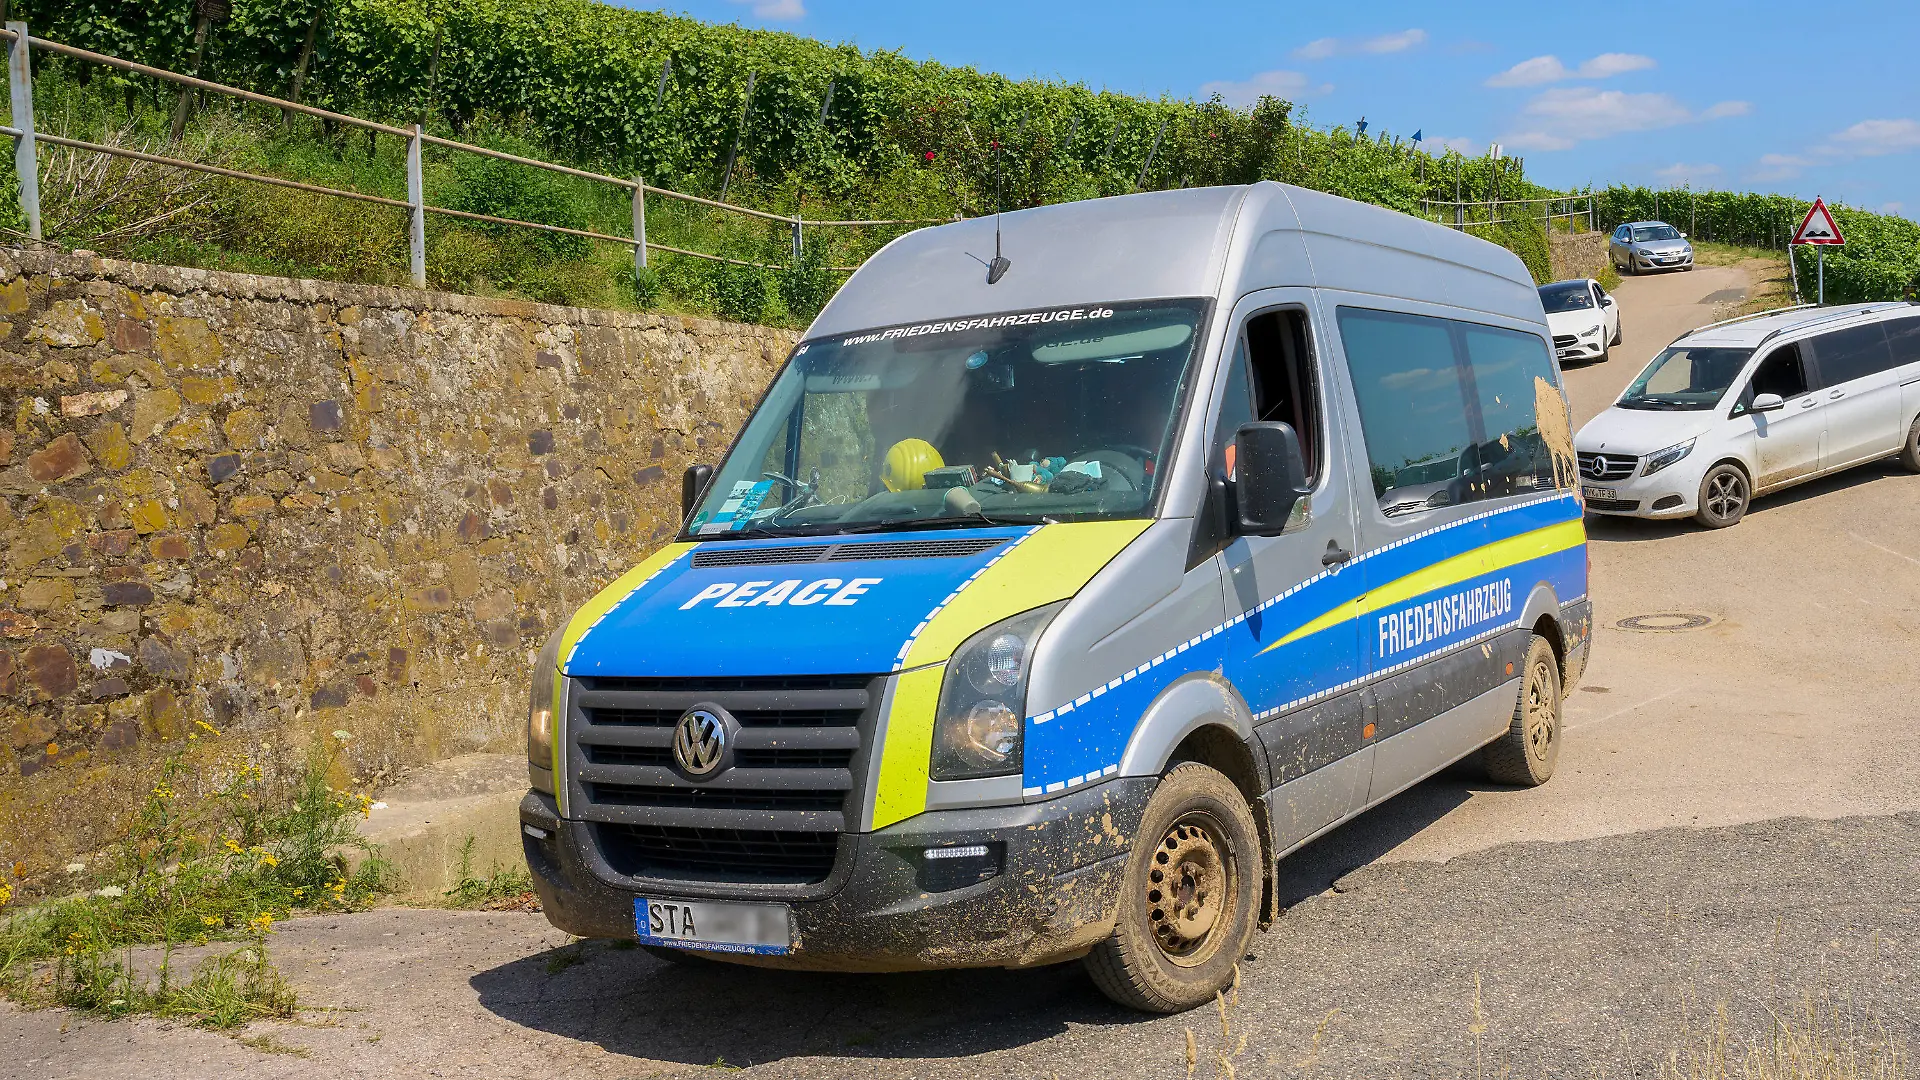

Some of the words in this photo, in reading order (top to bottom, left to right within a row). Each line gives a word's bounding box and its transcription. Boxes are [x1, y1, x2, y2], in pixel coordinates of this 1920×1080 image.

[843, 307, 1114, 347] www.FRIEDENSFAHRZEUGE.de
[678, 578, 884, 610] PEACE
[1378, 578, 1511, 659] FRIEDENSFAHRZEUG
[649, 903, 697, 936] STA
